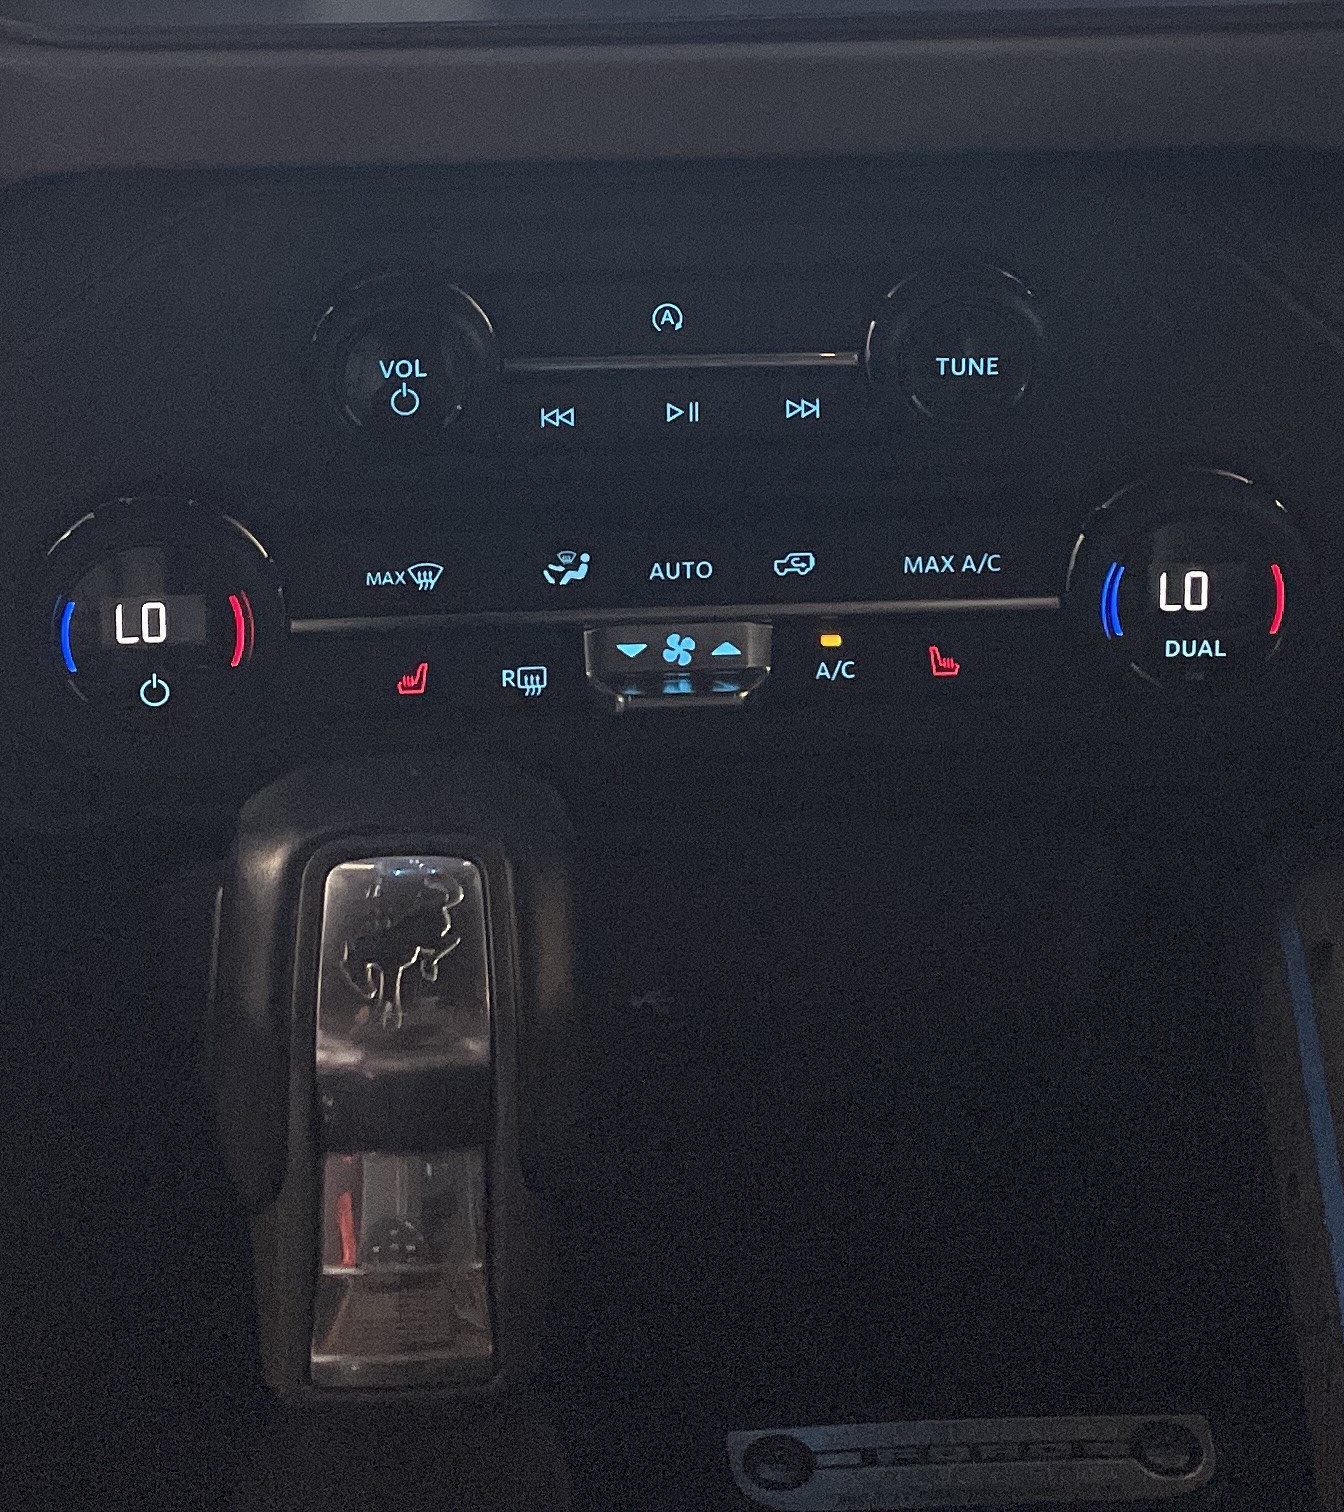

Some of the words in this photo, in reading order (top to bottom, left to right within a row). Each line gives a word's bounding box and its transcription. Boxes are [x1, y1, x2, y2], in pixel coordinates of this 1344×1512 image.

[379, 359, 428, 379] VOL
[935, 357, 999, 376] TUNE
[649, 560, 713, 580] AUTO
[904, 555, 955, 574] MAX
[961, 553, 1001, 574] A/C
[366, 571, 406, 586] MAX
[1159, 570, 1209, 612] LO
[115, 602, 167, 644] LO
[1165, 639, 1227, 658] DUAL
[502, 669, 516, 687] R
[815, 660, 855, 681] A/C
